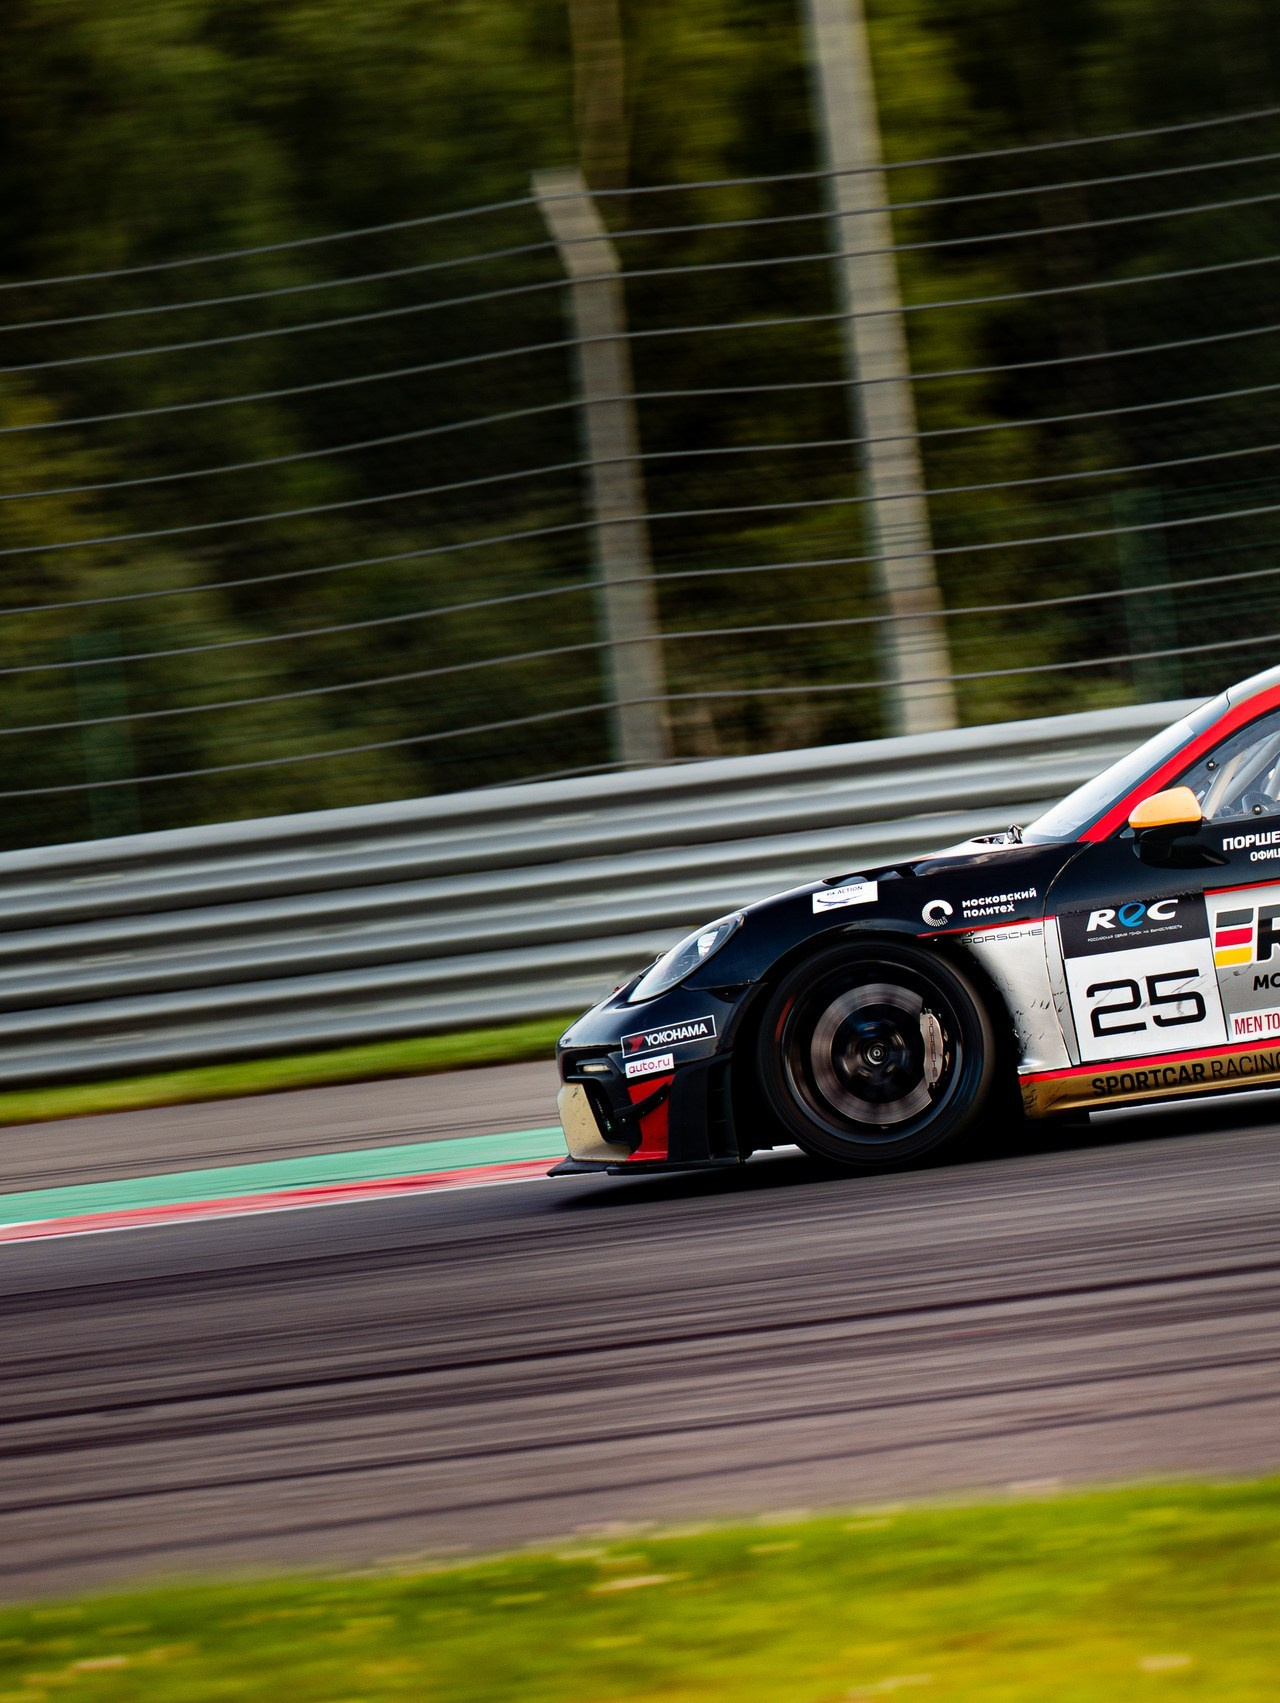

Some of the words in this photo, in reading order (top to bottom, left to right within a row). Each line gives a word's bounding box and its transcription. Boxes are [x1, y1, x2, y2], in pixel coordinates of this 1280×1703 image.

[961, 928, 1043, 945] PORSCHE
[1086, 968, 1206, 1038] 25
[644, 1023, 708, 1046] YOKOHAMA
[1234, 1015, 1263, 1035] MEN
[628, 1058, 670, 1074] auto.ru
[1091, 1063, 1205, 1097] SPORTCAR
